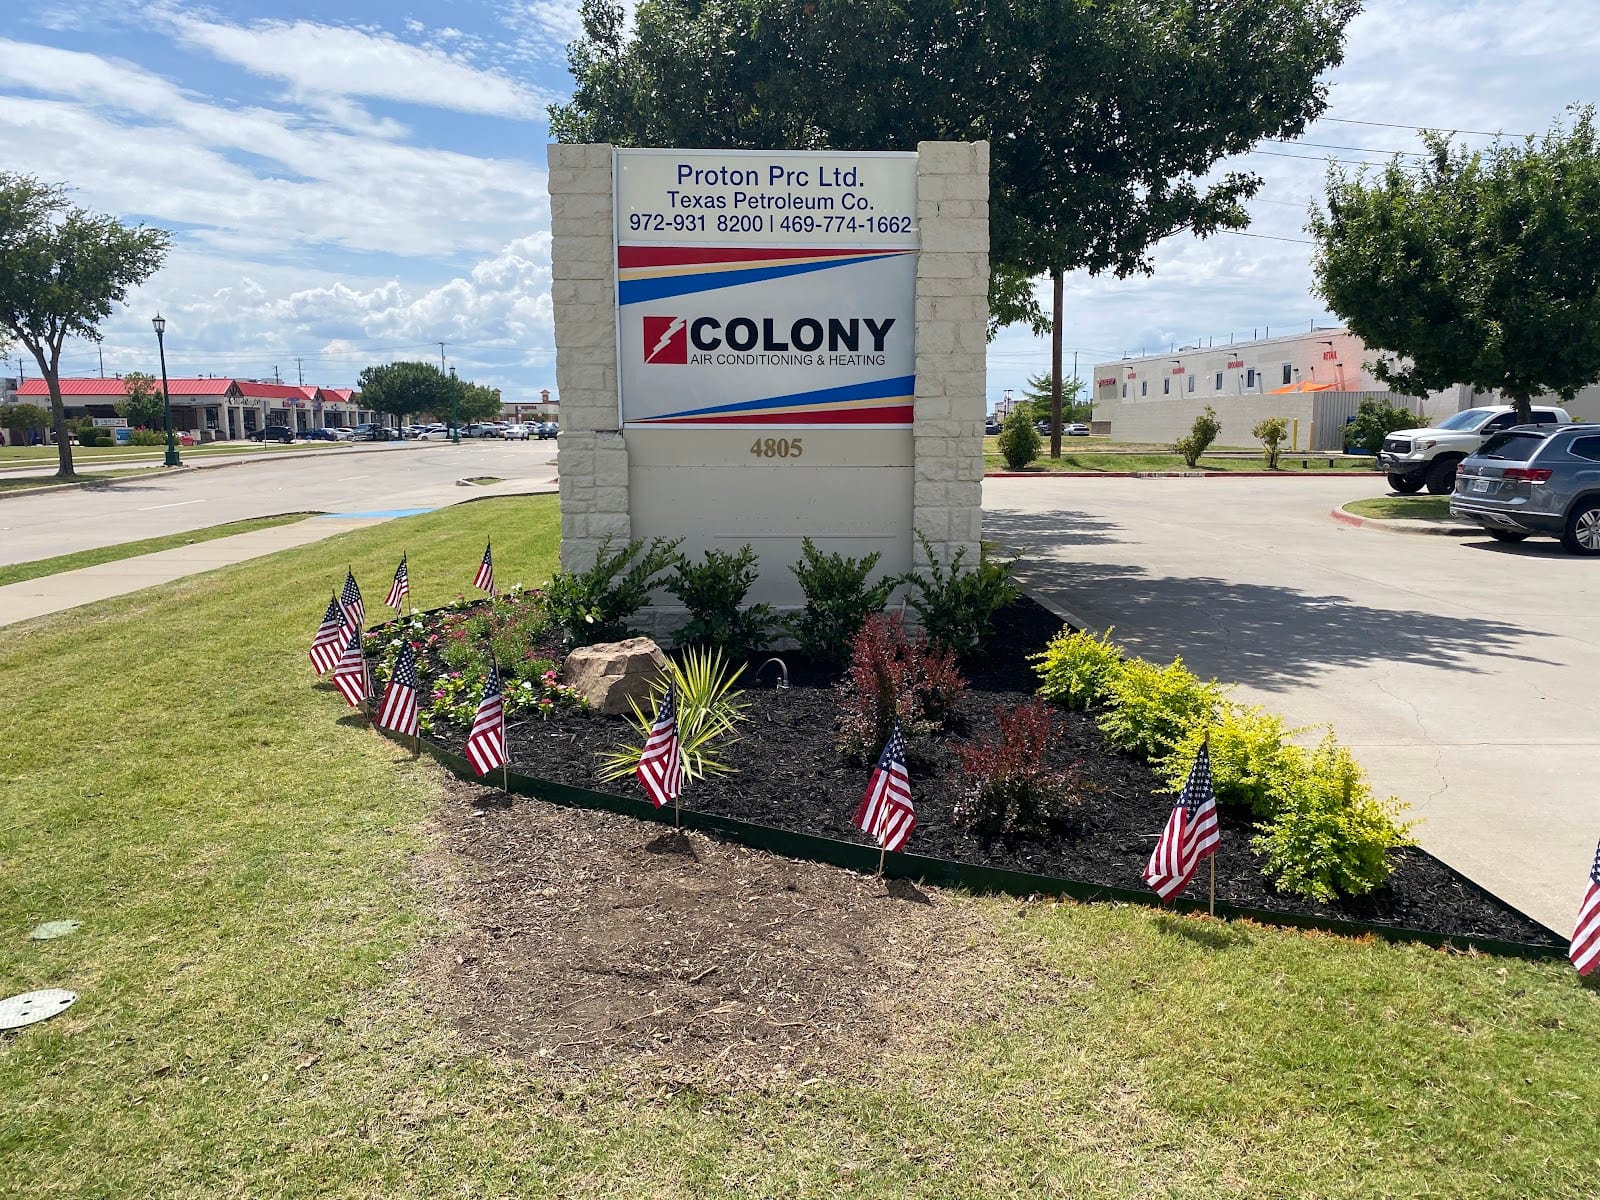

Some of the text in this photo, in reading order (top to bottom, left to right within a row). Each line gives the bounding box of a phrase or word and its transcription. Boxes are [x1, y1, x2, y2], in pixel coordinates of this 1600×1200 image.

[677, 164, 865, 188] Proton Prc Ltd.
[667, 191, 874, 211] Texas Petroleum Co.
[630, 213, 706, 232] 972-931
[717, 214, 764, 233] 8200
[779, 215, 912, 234] 469-774-1662
[690, 316, 896, 352] COLONY
[691, 354, 886, 366] AIR CONDITIONING & HEATING
[750, 438, 803, 458] 4805
